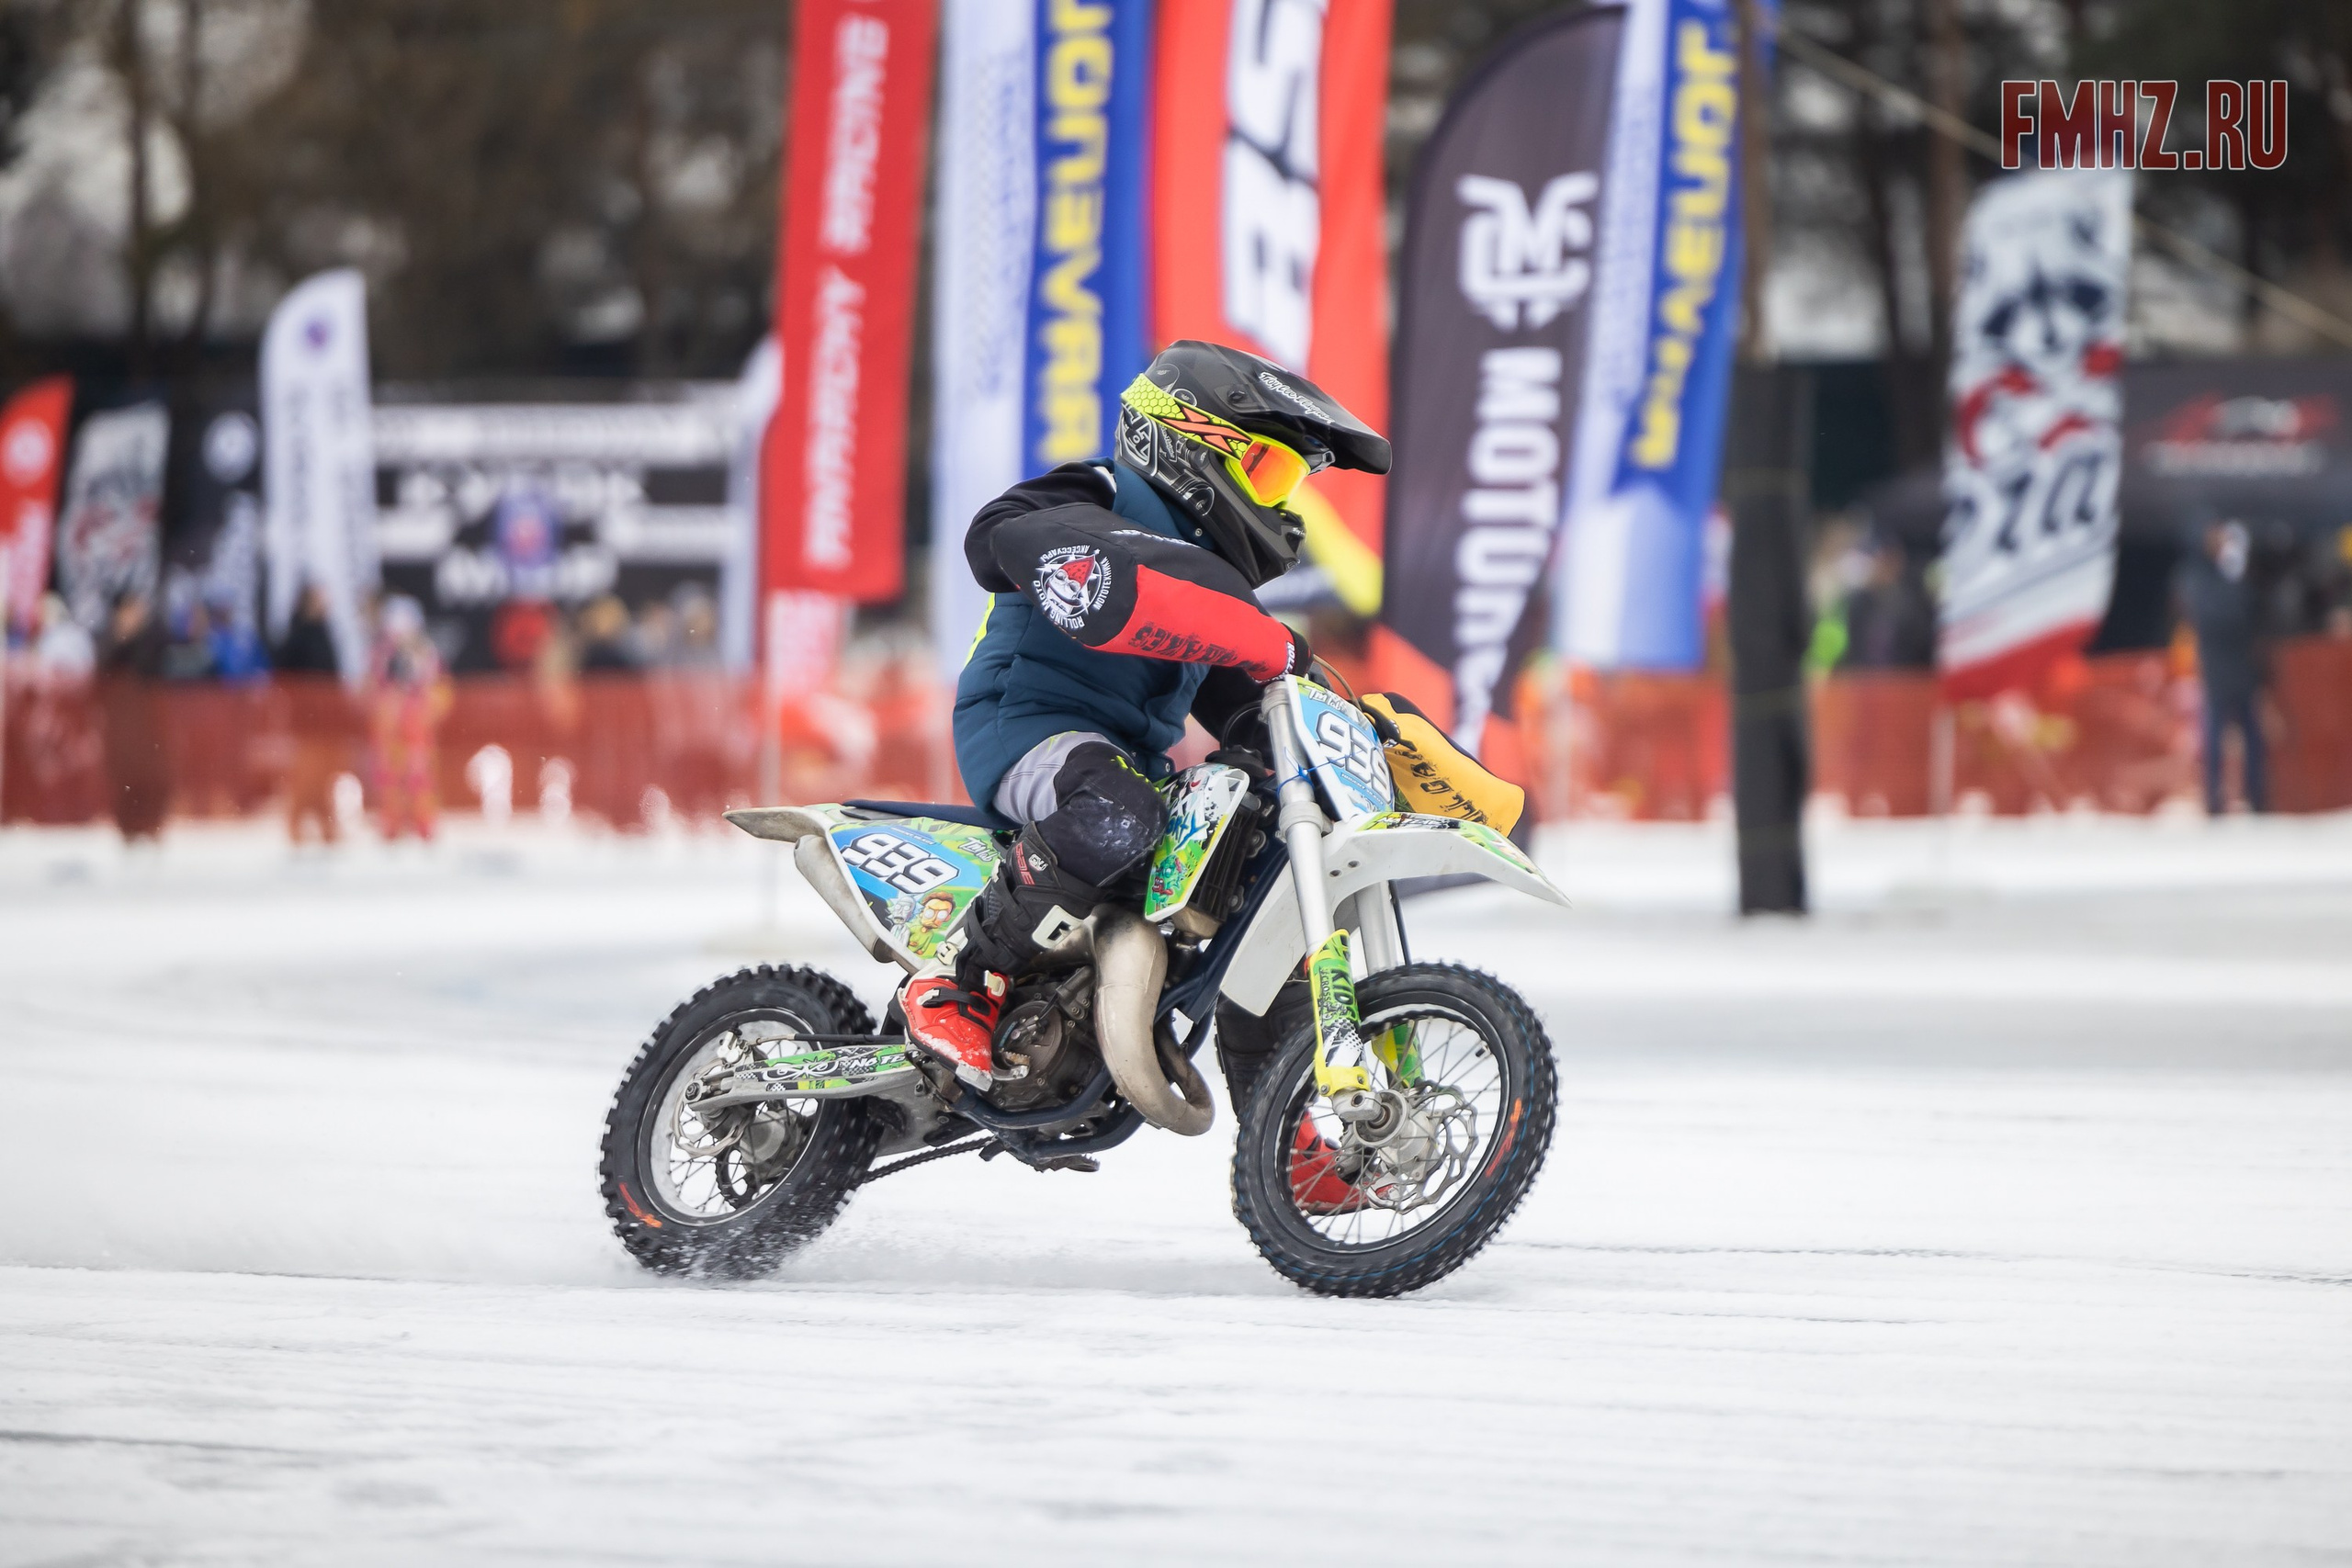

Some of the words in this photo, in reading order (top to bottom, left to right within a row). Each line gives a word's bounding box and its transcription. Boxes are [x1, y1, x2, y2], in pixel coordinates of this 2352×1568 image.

[1039, 544, 1091, 563] АКСЕССУАРЫ
[1033, 580, 1051, 612] MOTO
[1049, 609, 1086, 629] ROLLING
[840, 832, 961, 896] 939
